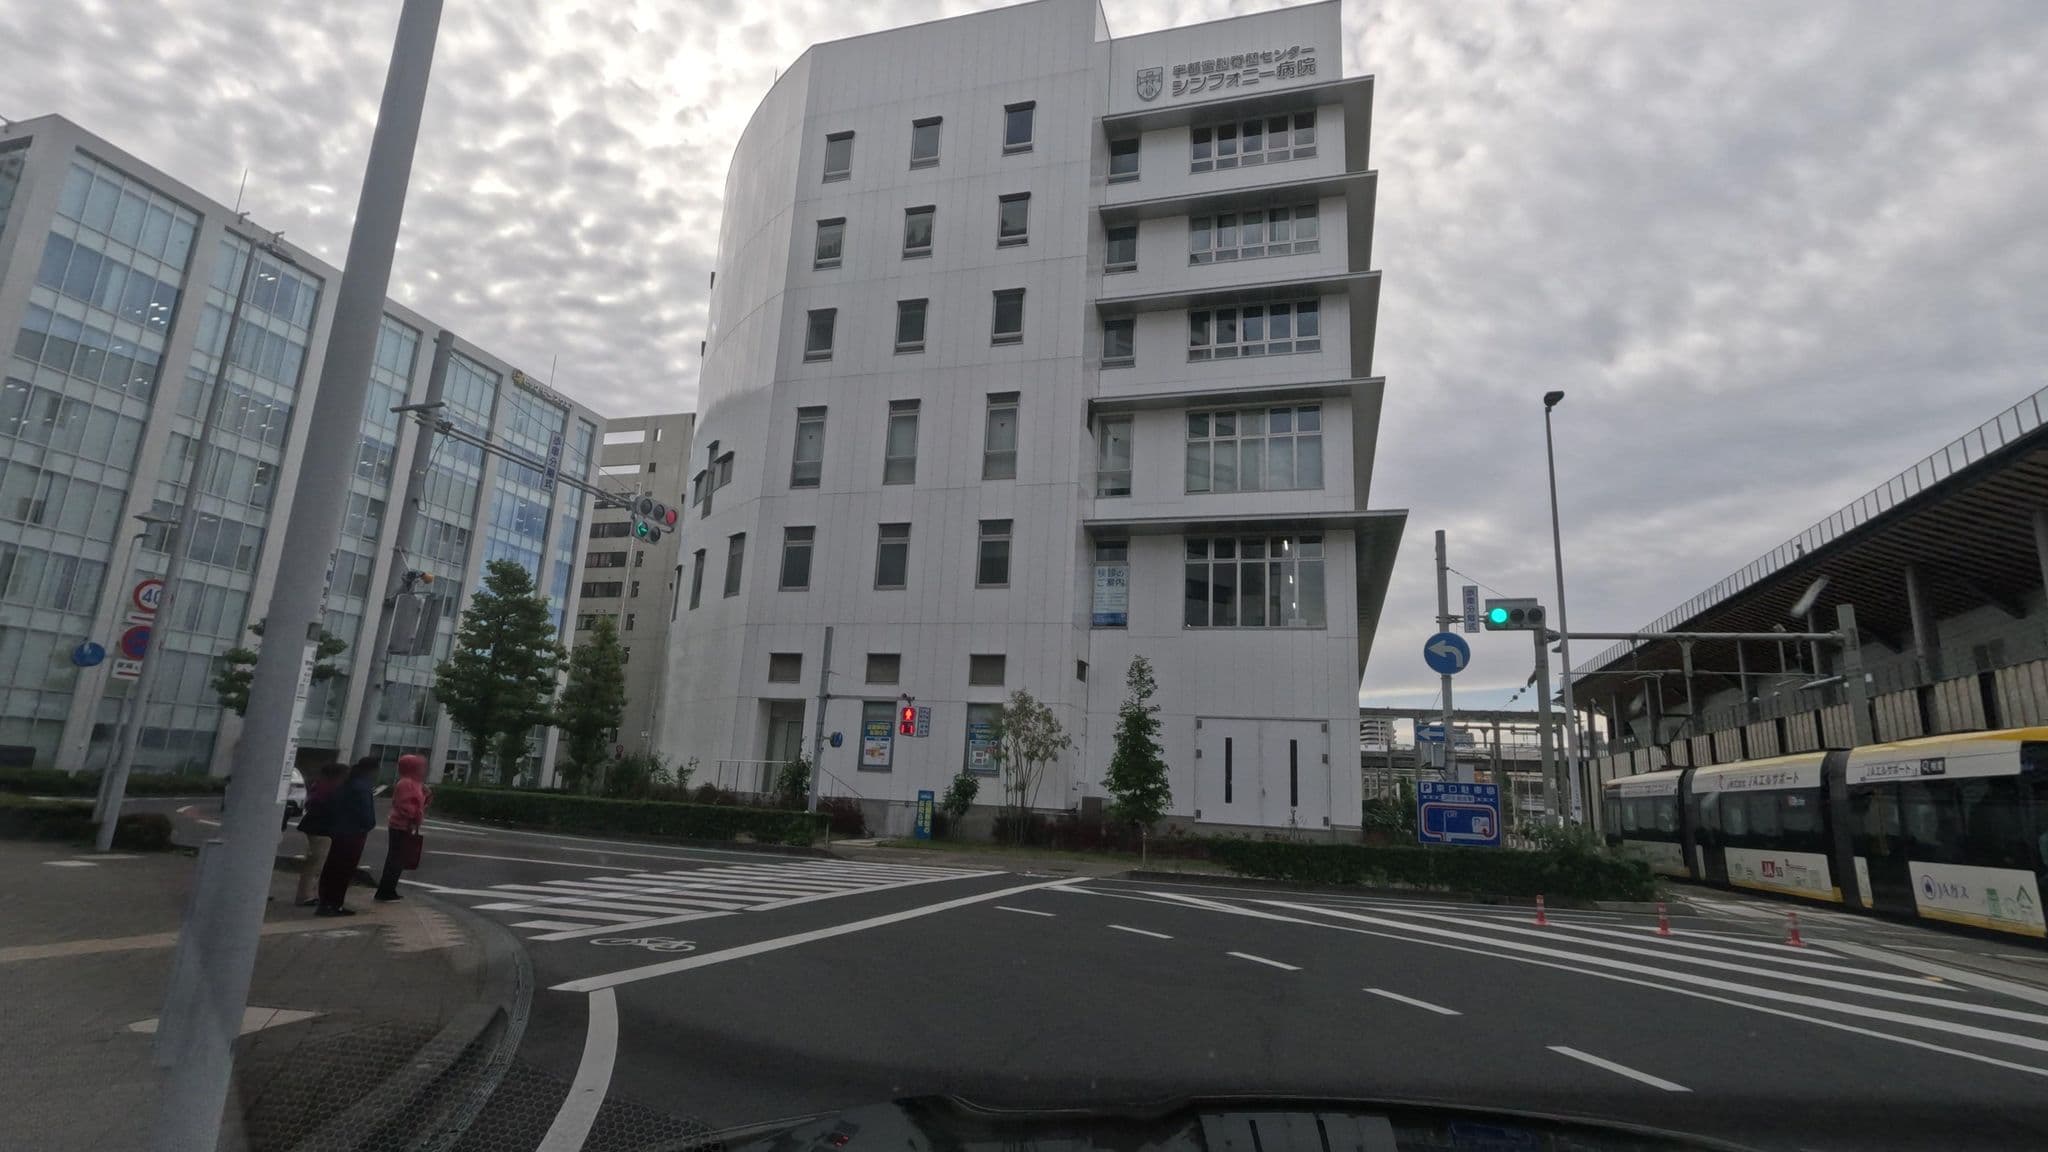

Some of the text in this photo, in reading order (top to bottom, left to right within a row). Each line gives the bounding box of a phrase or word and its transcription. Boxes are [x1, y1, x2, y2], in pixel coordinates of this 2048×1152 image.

[1172, 57, 1316, 96] シンフォニー病院
[544, 434, 561, 490] 歩車分離式
[1749, 771, 1800, 787] JAエルサポート
